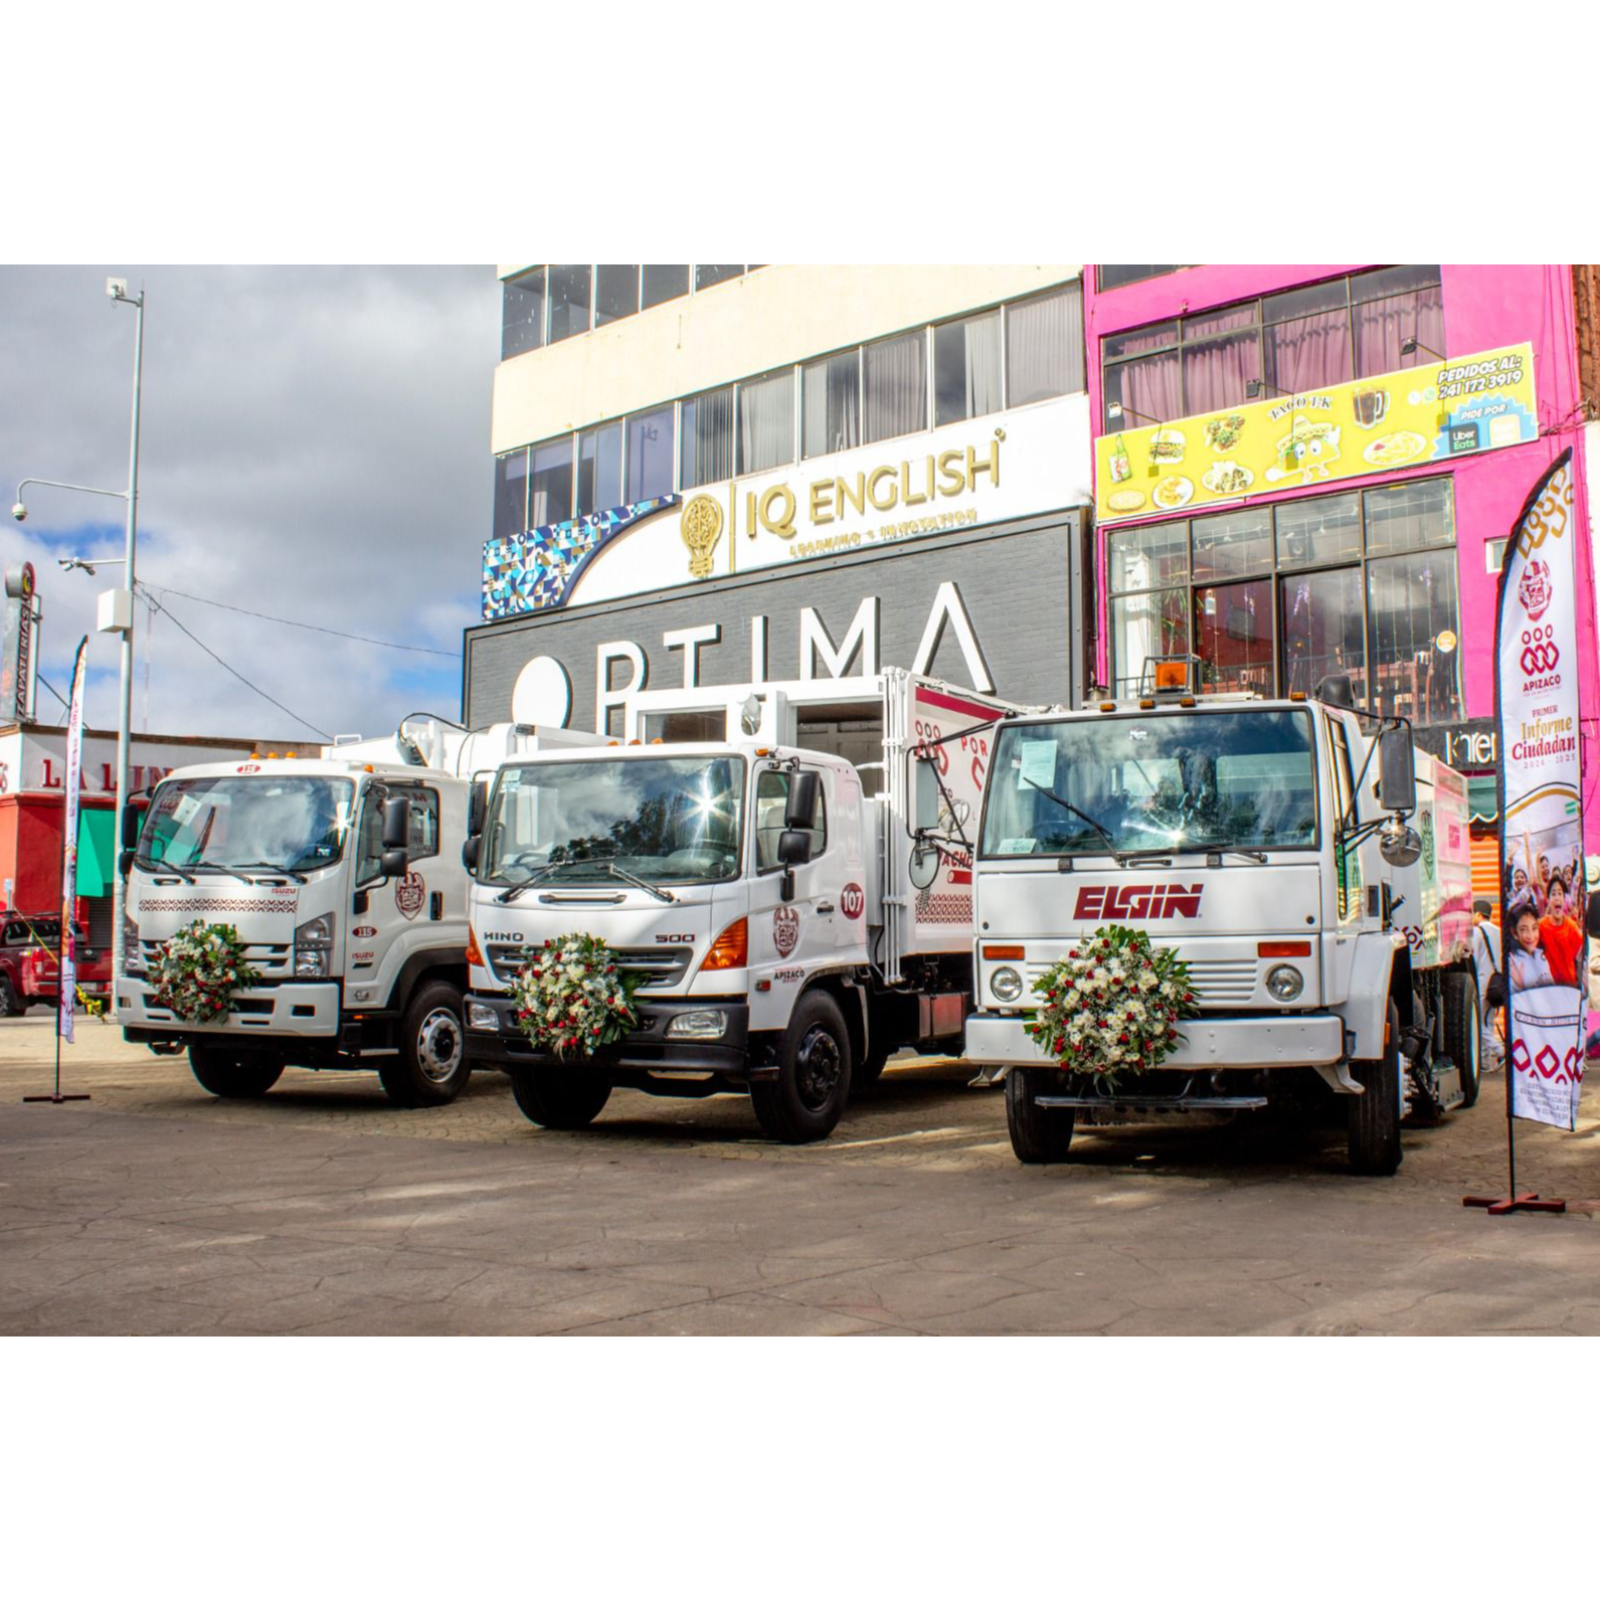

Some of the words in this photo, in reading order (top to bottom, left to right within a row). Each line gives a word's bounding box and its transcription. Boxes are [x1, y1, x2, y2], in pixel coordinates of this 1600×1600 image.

[1437, 357, 1499, 385] PEDIDOS
[1499, 354, 1523, 371] AL:
[1438, 381, 1462, 400] 241
[1464, 376, 1487, 394] 172
[1488, 369, 1524, 389] 3919
[1460, 408, 1483, 421] PIDE
[1453, 431, 1476, 441] Uber
[1454, 440, 1476, 450] Eats
[746, 483, 798, 540] IQ
[809, 440, 999, 526] ENGLISH
[1522, 674, 1561, 692] APIZACO
[1532, 705, 1558, 717] PRIMER
[1521, 716, 1573, 742] Informe
[960, 735, 988, 757] POR
[271, 887, 297, 895] ISUZU
[842, 891, 863, 912] 107
[1073, 884, 1204, 920] ELGIN
[358, 927, 373, 937] 115
[484, 931, 525, 942] HINO
[655, 933, 696, 943] 500
[352, 951, 375, 960] ISUZU
[773, 969, 805, 980] APIZACO
